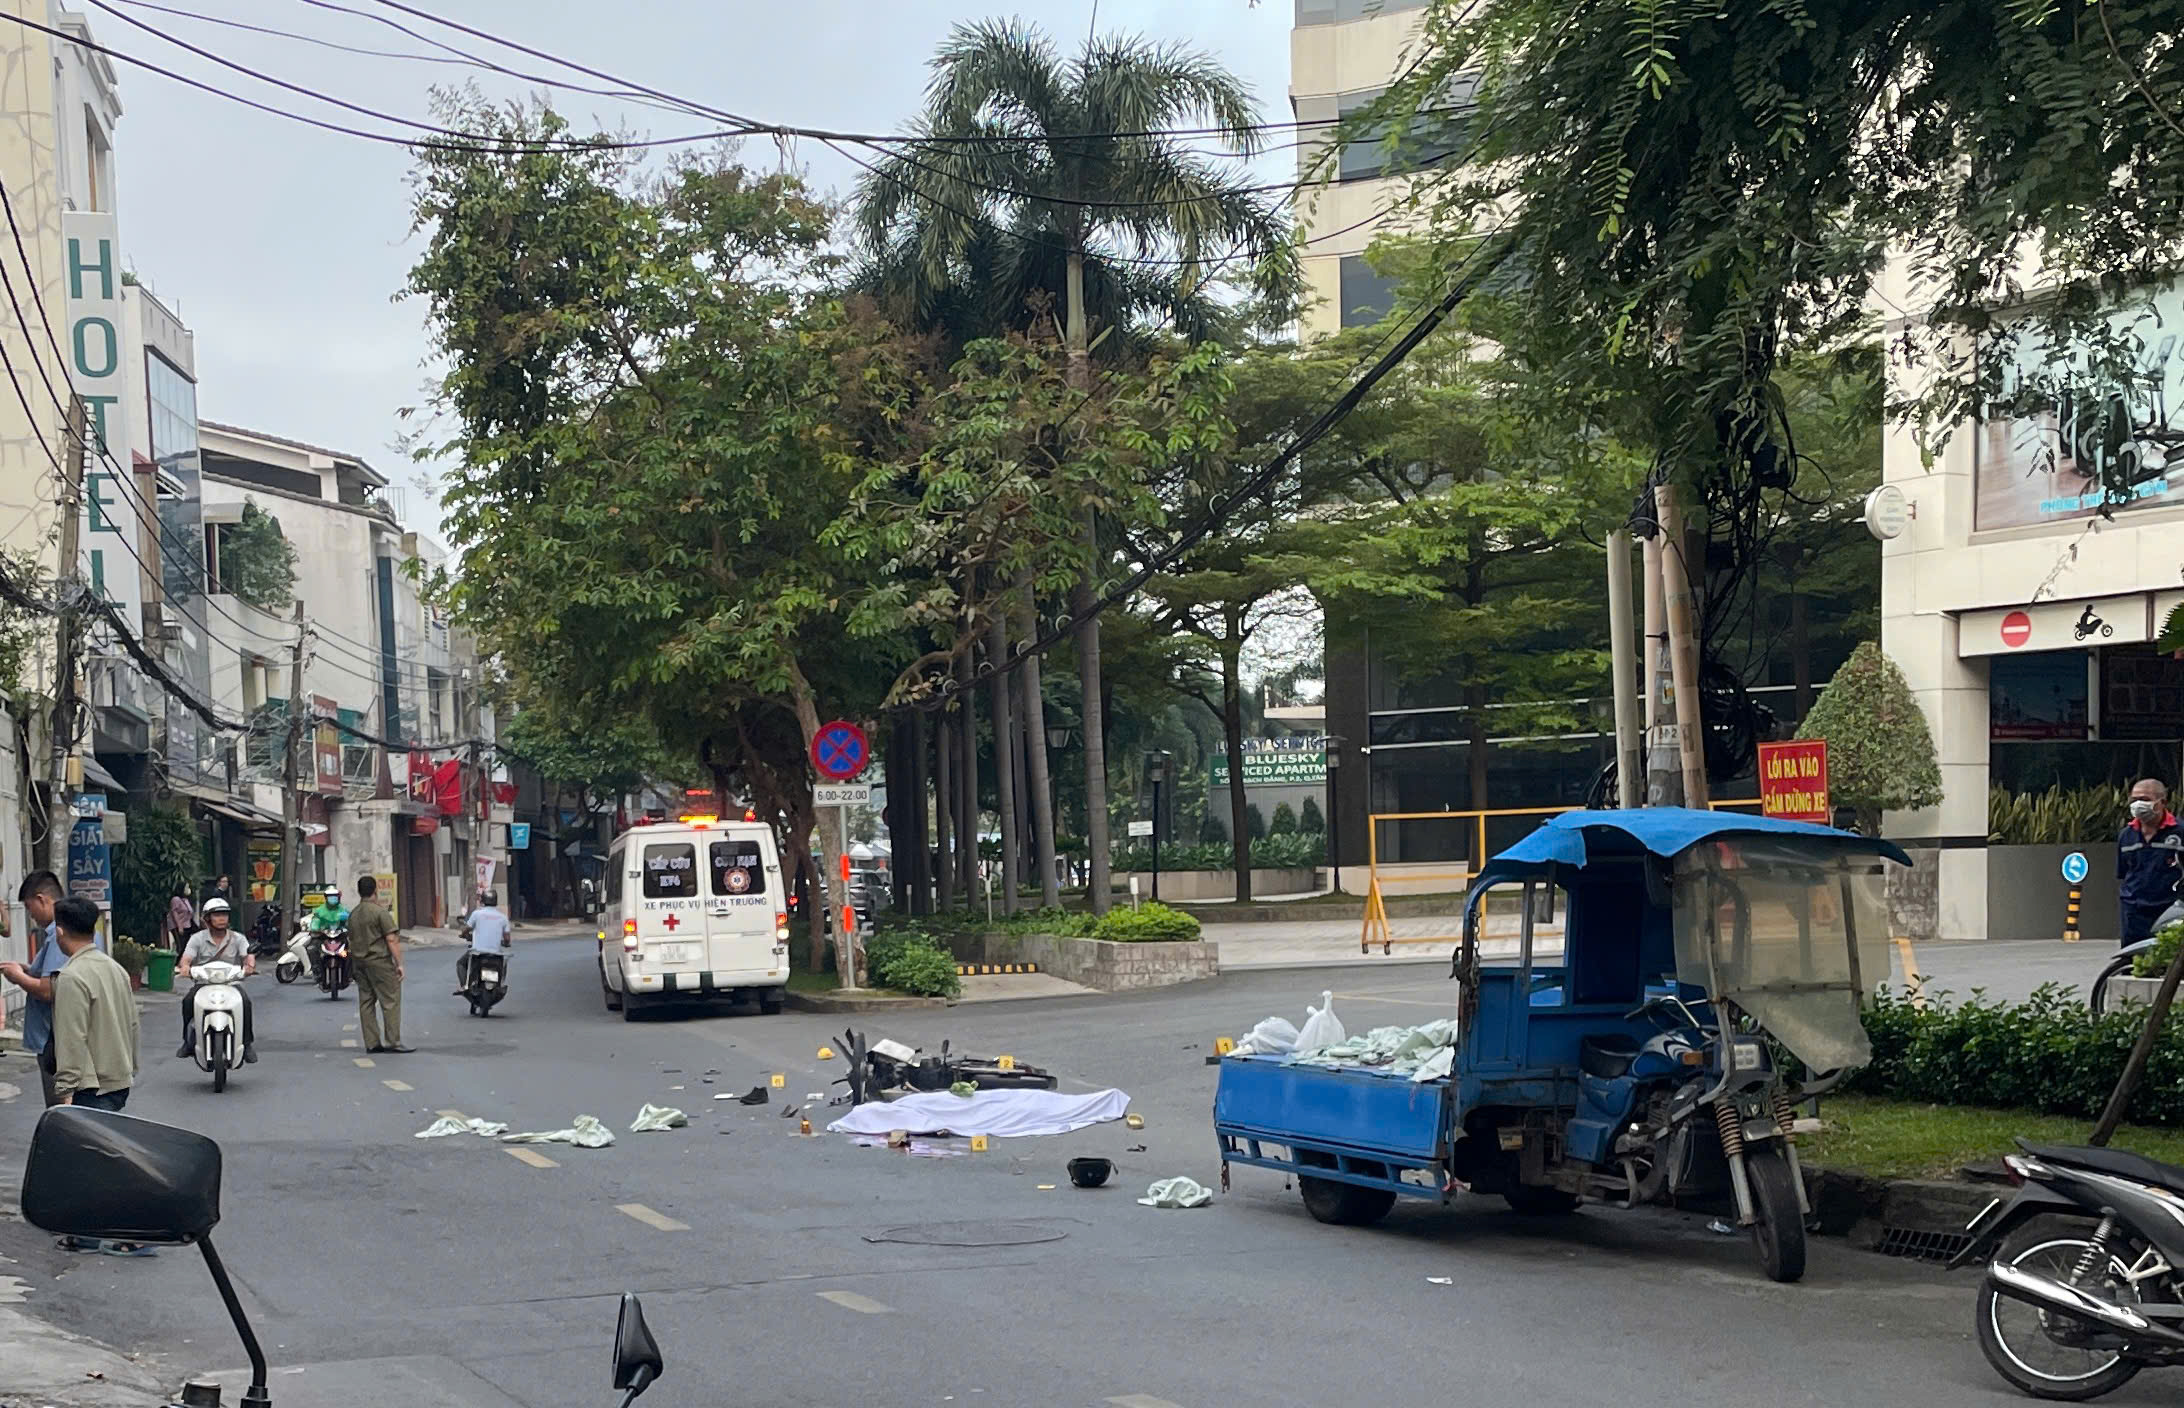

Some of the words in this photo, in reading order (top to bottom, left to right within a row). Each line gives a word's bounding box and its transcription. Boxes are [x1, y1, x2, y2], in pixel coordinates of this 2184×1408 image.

[68, 238, 127, 609] HOTEL
[1214, 766, 1273, 777] SEICED
[1274, 764, 1327, 775] APARTM
[1245, 753, 1320, 765] BLUESKY
[1767, 750, 1783, 779] LỐI
[1783, 758, 1798, 778] RA
[1799, 751, 1819, 777] VÀO
[1764, 784, 1785, 814] CẤM
[1785, 787, 1812, 813] DỪNG
[1813, 792, 1825, 812] XE
[73, 850, 104, 875] SẤY
[645, 902, 656, 910] XE
